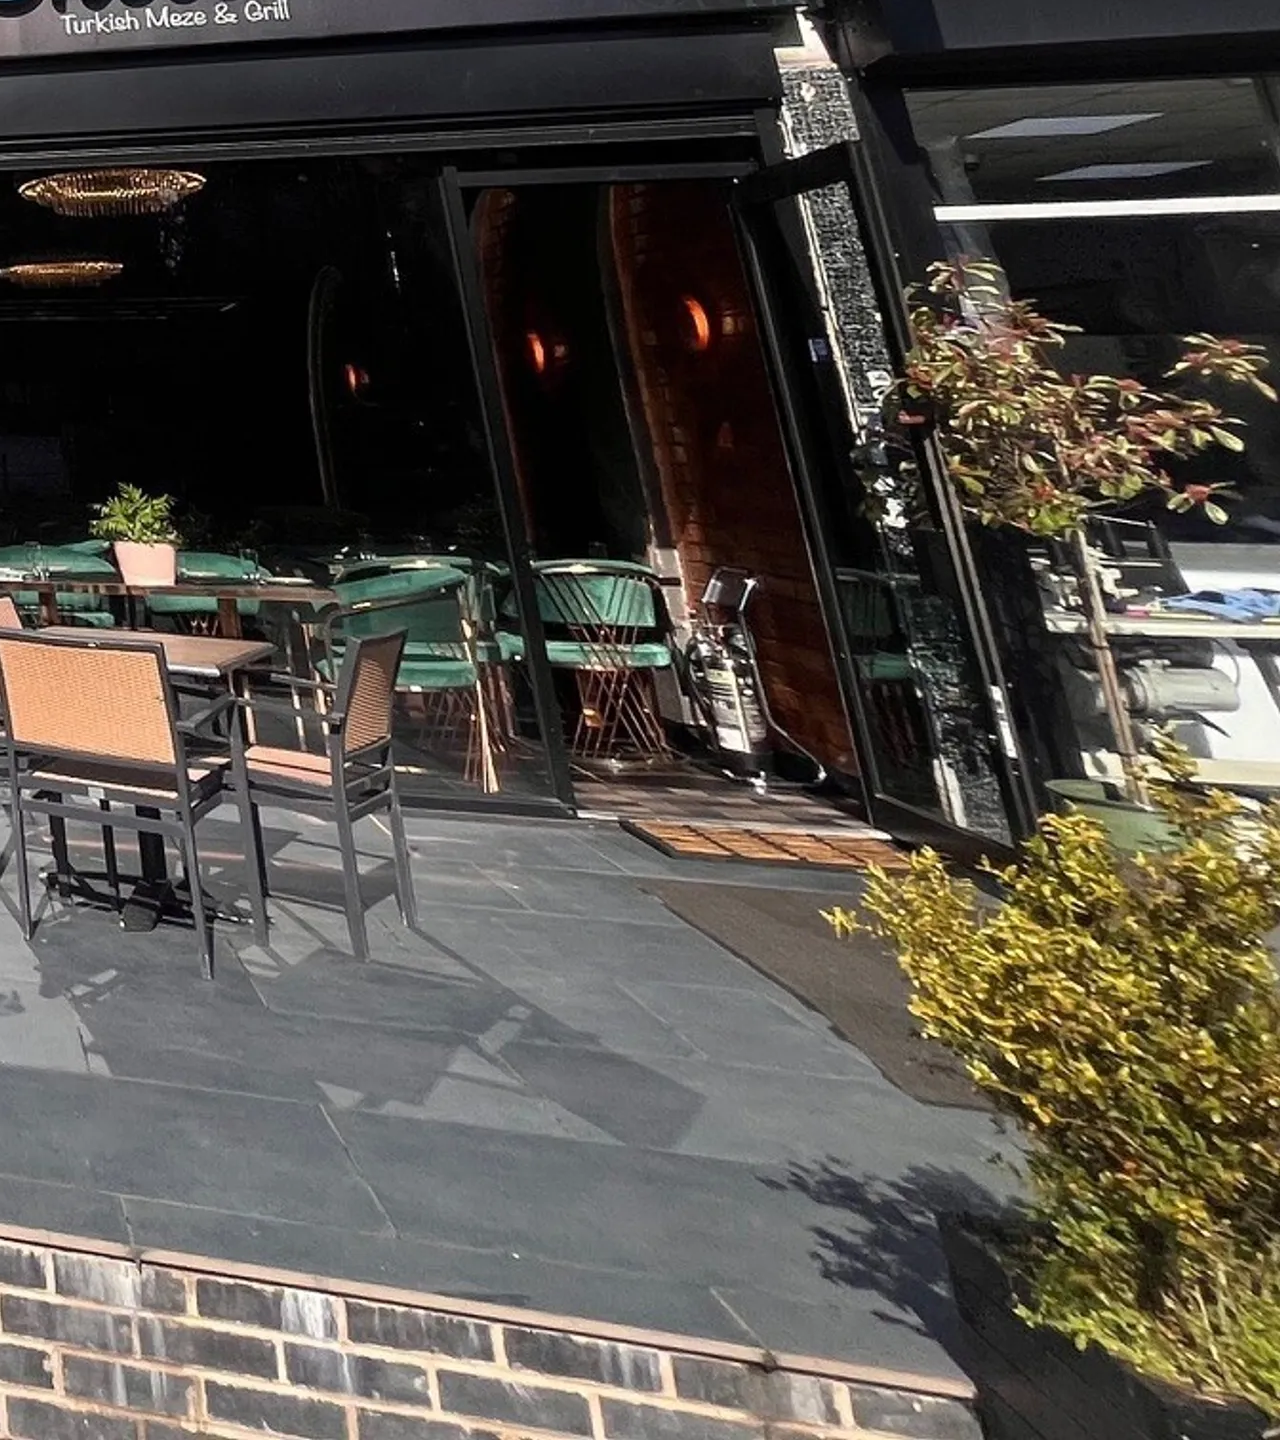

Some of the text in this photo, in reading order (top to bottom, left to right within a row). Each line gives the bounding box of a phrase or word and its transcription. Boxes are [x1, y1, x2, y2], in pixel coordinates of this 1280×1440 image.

[59, 10, 140, 36] Turkish
[145, 6, 208, 29] Meze
[213, 1, 239, 25] &
